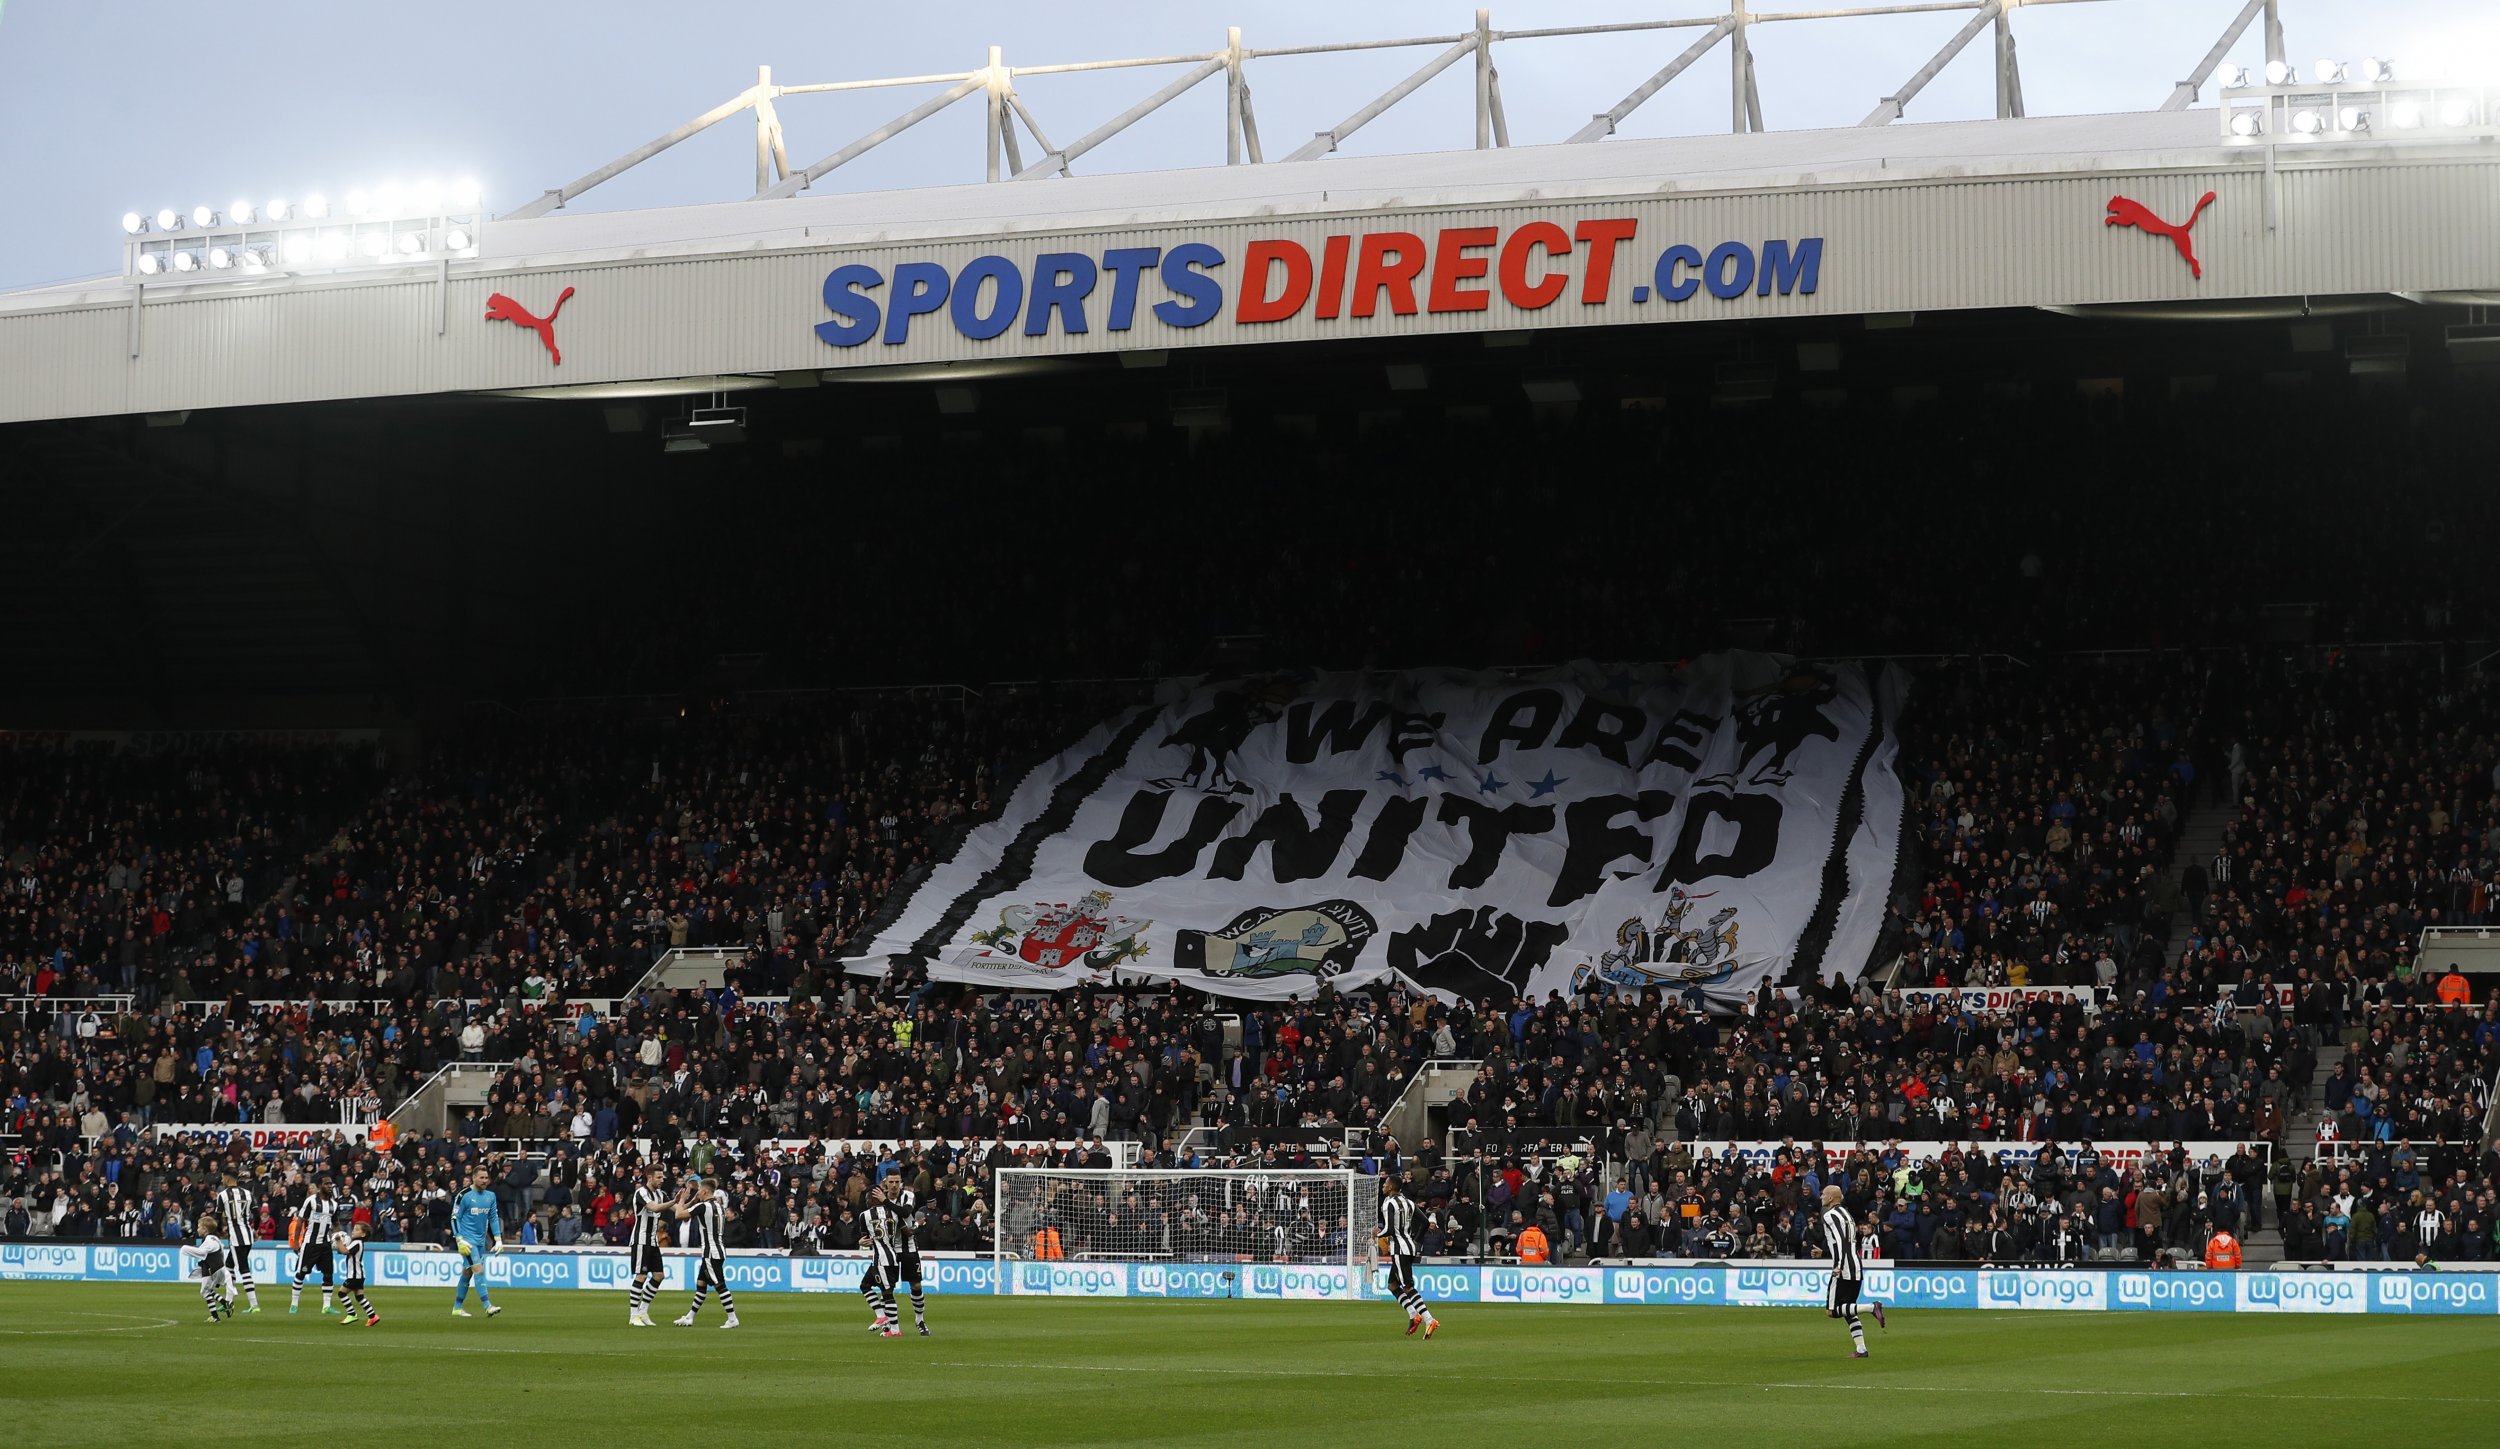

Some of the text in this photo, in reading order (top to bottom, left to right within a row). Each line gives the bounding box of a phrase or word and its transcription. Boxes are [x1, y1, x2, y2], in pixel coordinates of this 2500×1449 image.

[1285, 688, 1722, 774] WE ARE
[229, 1200, 248, 1220] 17
[869, 1218, 896, 1240] 30
